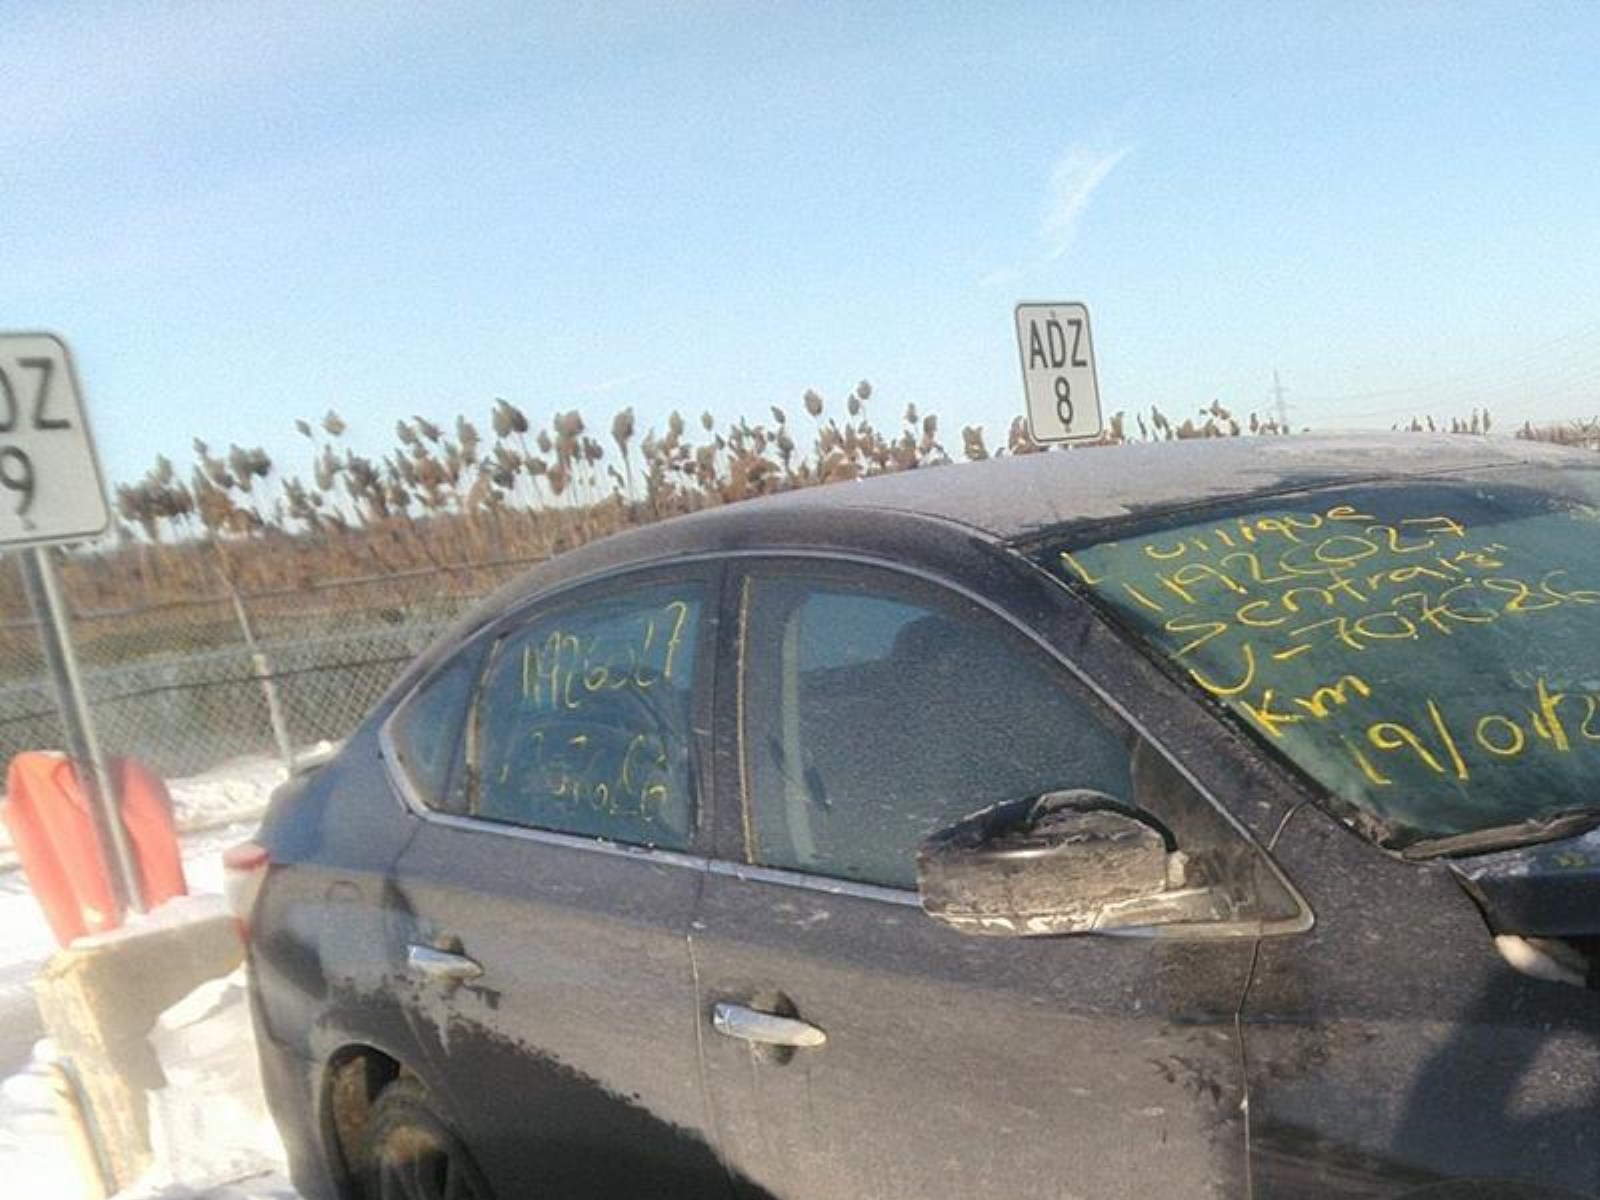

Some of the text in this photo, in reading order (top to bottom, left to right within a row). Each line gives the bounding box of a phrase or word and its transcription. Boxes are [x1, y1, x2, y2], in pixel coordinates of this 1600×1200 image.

[1029, 319, 1088, 370] ADZ
[1054, 376, 1074, 425] 8
[0, 445, 36, 515] 9
